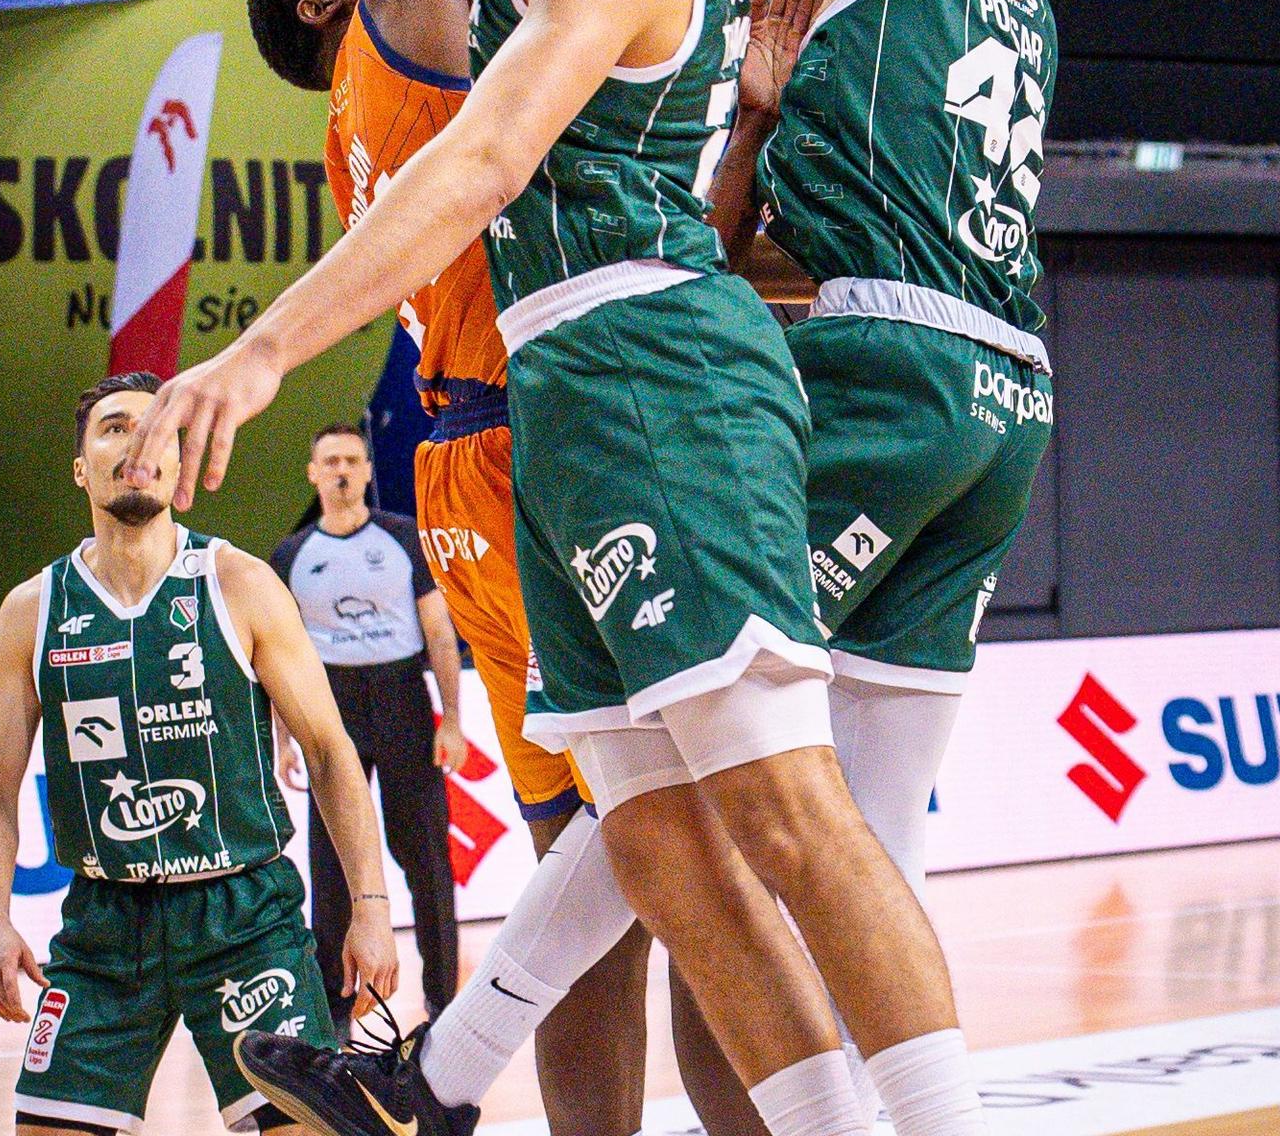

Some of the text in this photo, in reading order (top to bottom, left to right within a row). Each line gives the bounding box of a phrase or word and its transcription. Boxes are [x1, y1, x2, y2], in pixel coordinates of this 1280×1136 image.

[584, 539, 635, 606] LOTTO
[811, 549, 857, 593] ORLEN
[51, 650, 88, 664] ORLEN
[168, 642, 206, 690] 3
[138, 698, 214, 726] ORLEN
[138, 719, 220, 744] TERMIKA
[119, 788, 187, 831] LOTTO
[126, 849, 233, 880] TRAMWAJE
[228, 976, 281, 1022] LOTTO
